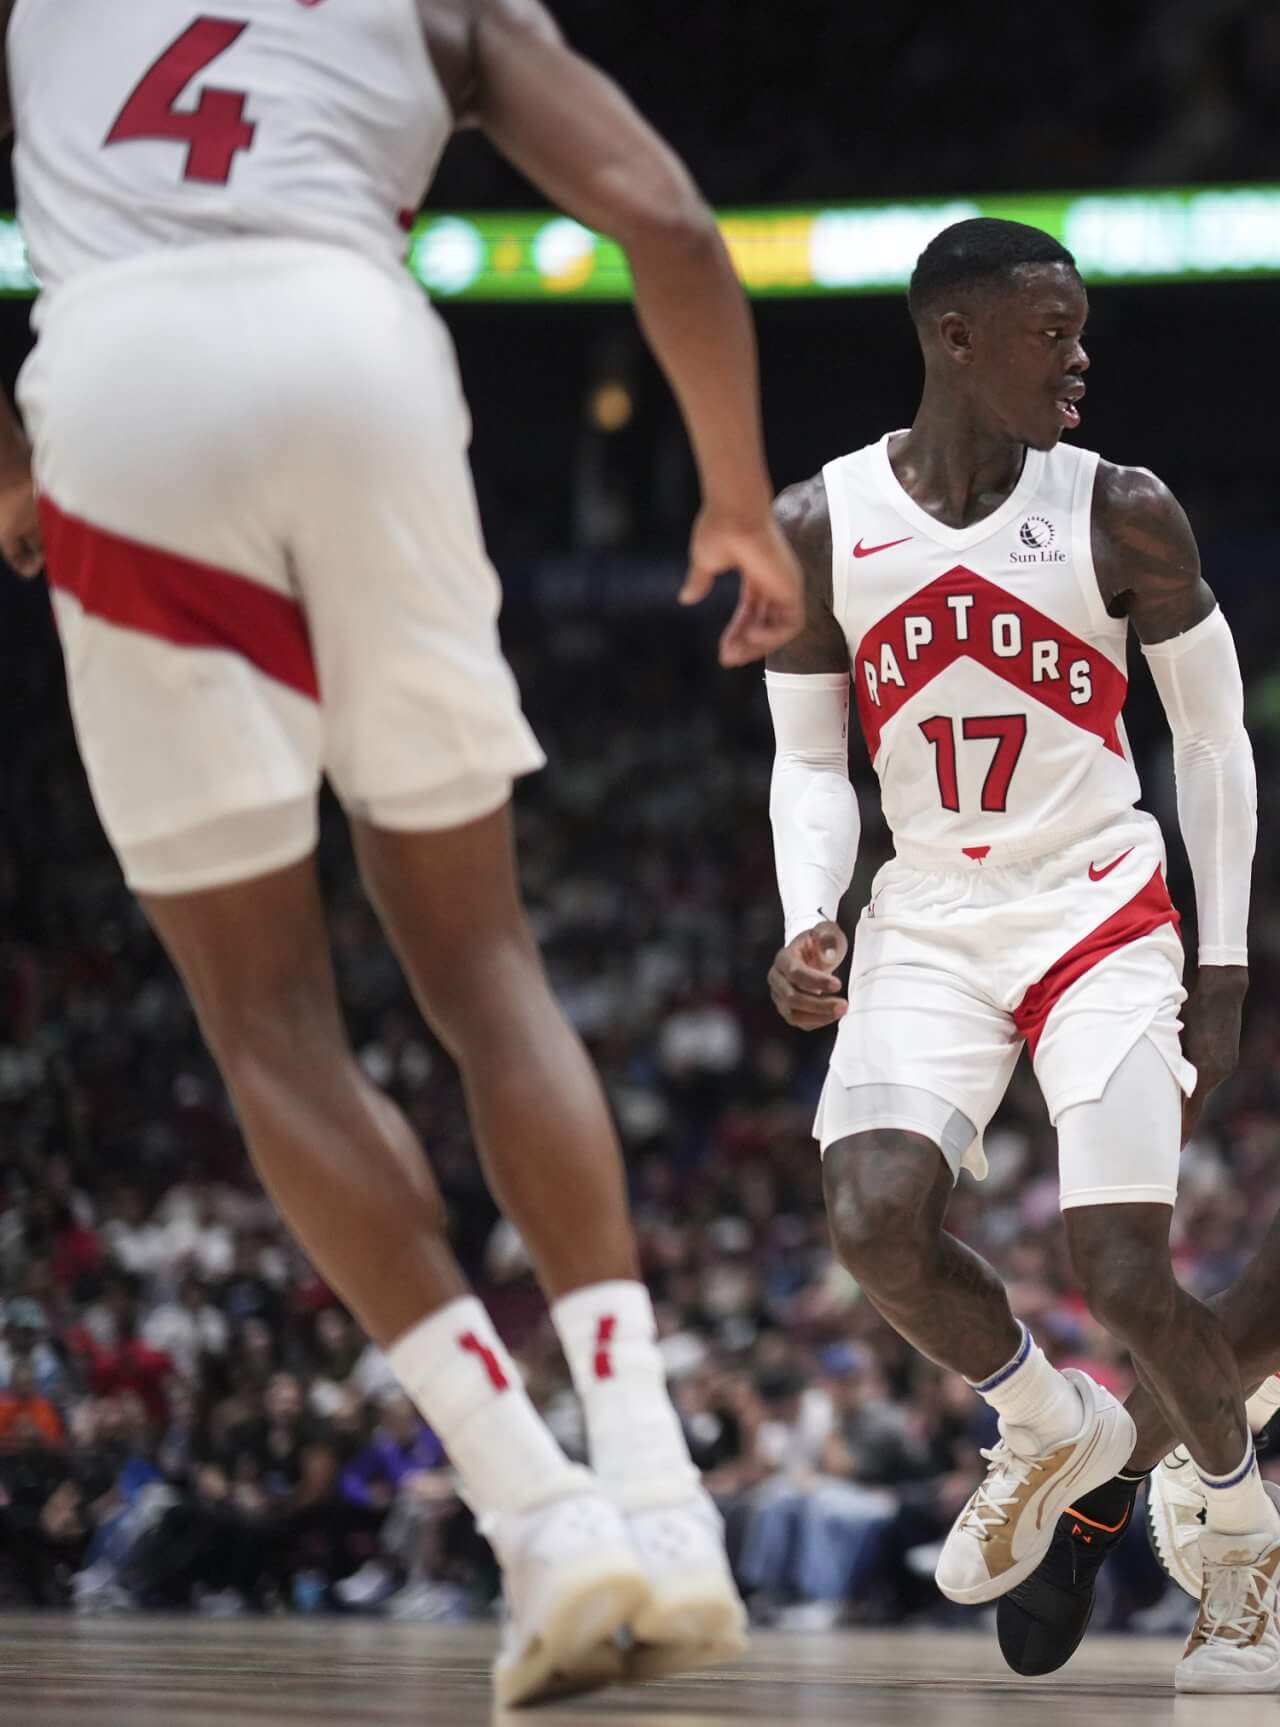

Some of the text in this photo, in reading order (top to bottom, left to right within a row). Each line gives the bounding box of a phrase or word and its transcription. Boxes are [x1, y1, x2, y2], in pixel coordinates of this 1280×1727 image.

[102, 15, 256, 186] 4
[1009, 550, 1066, 563] Sun Life
[864, 595, 1092, 707] RAPTORS
[918, 713, 1027, 813] 17
